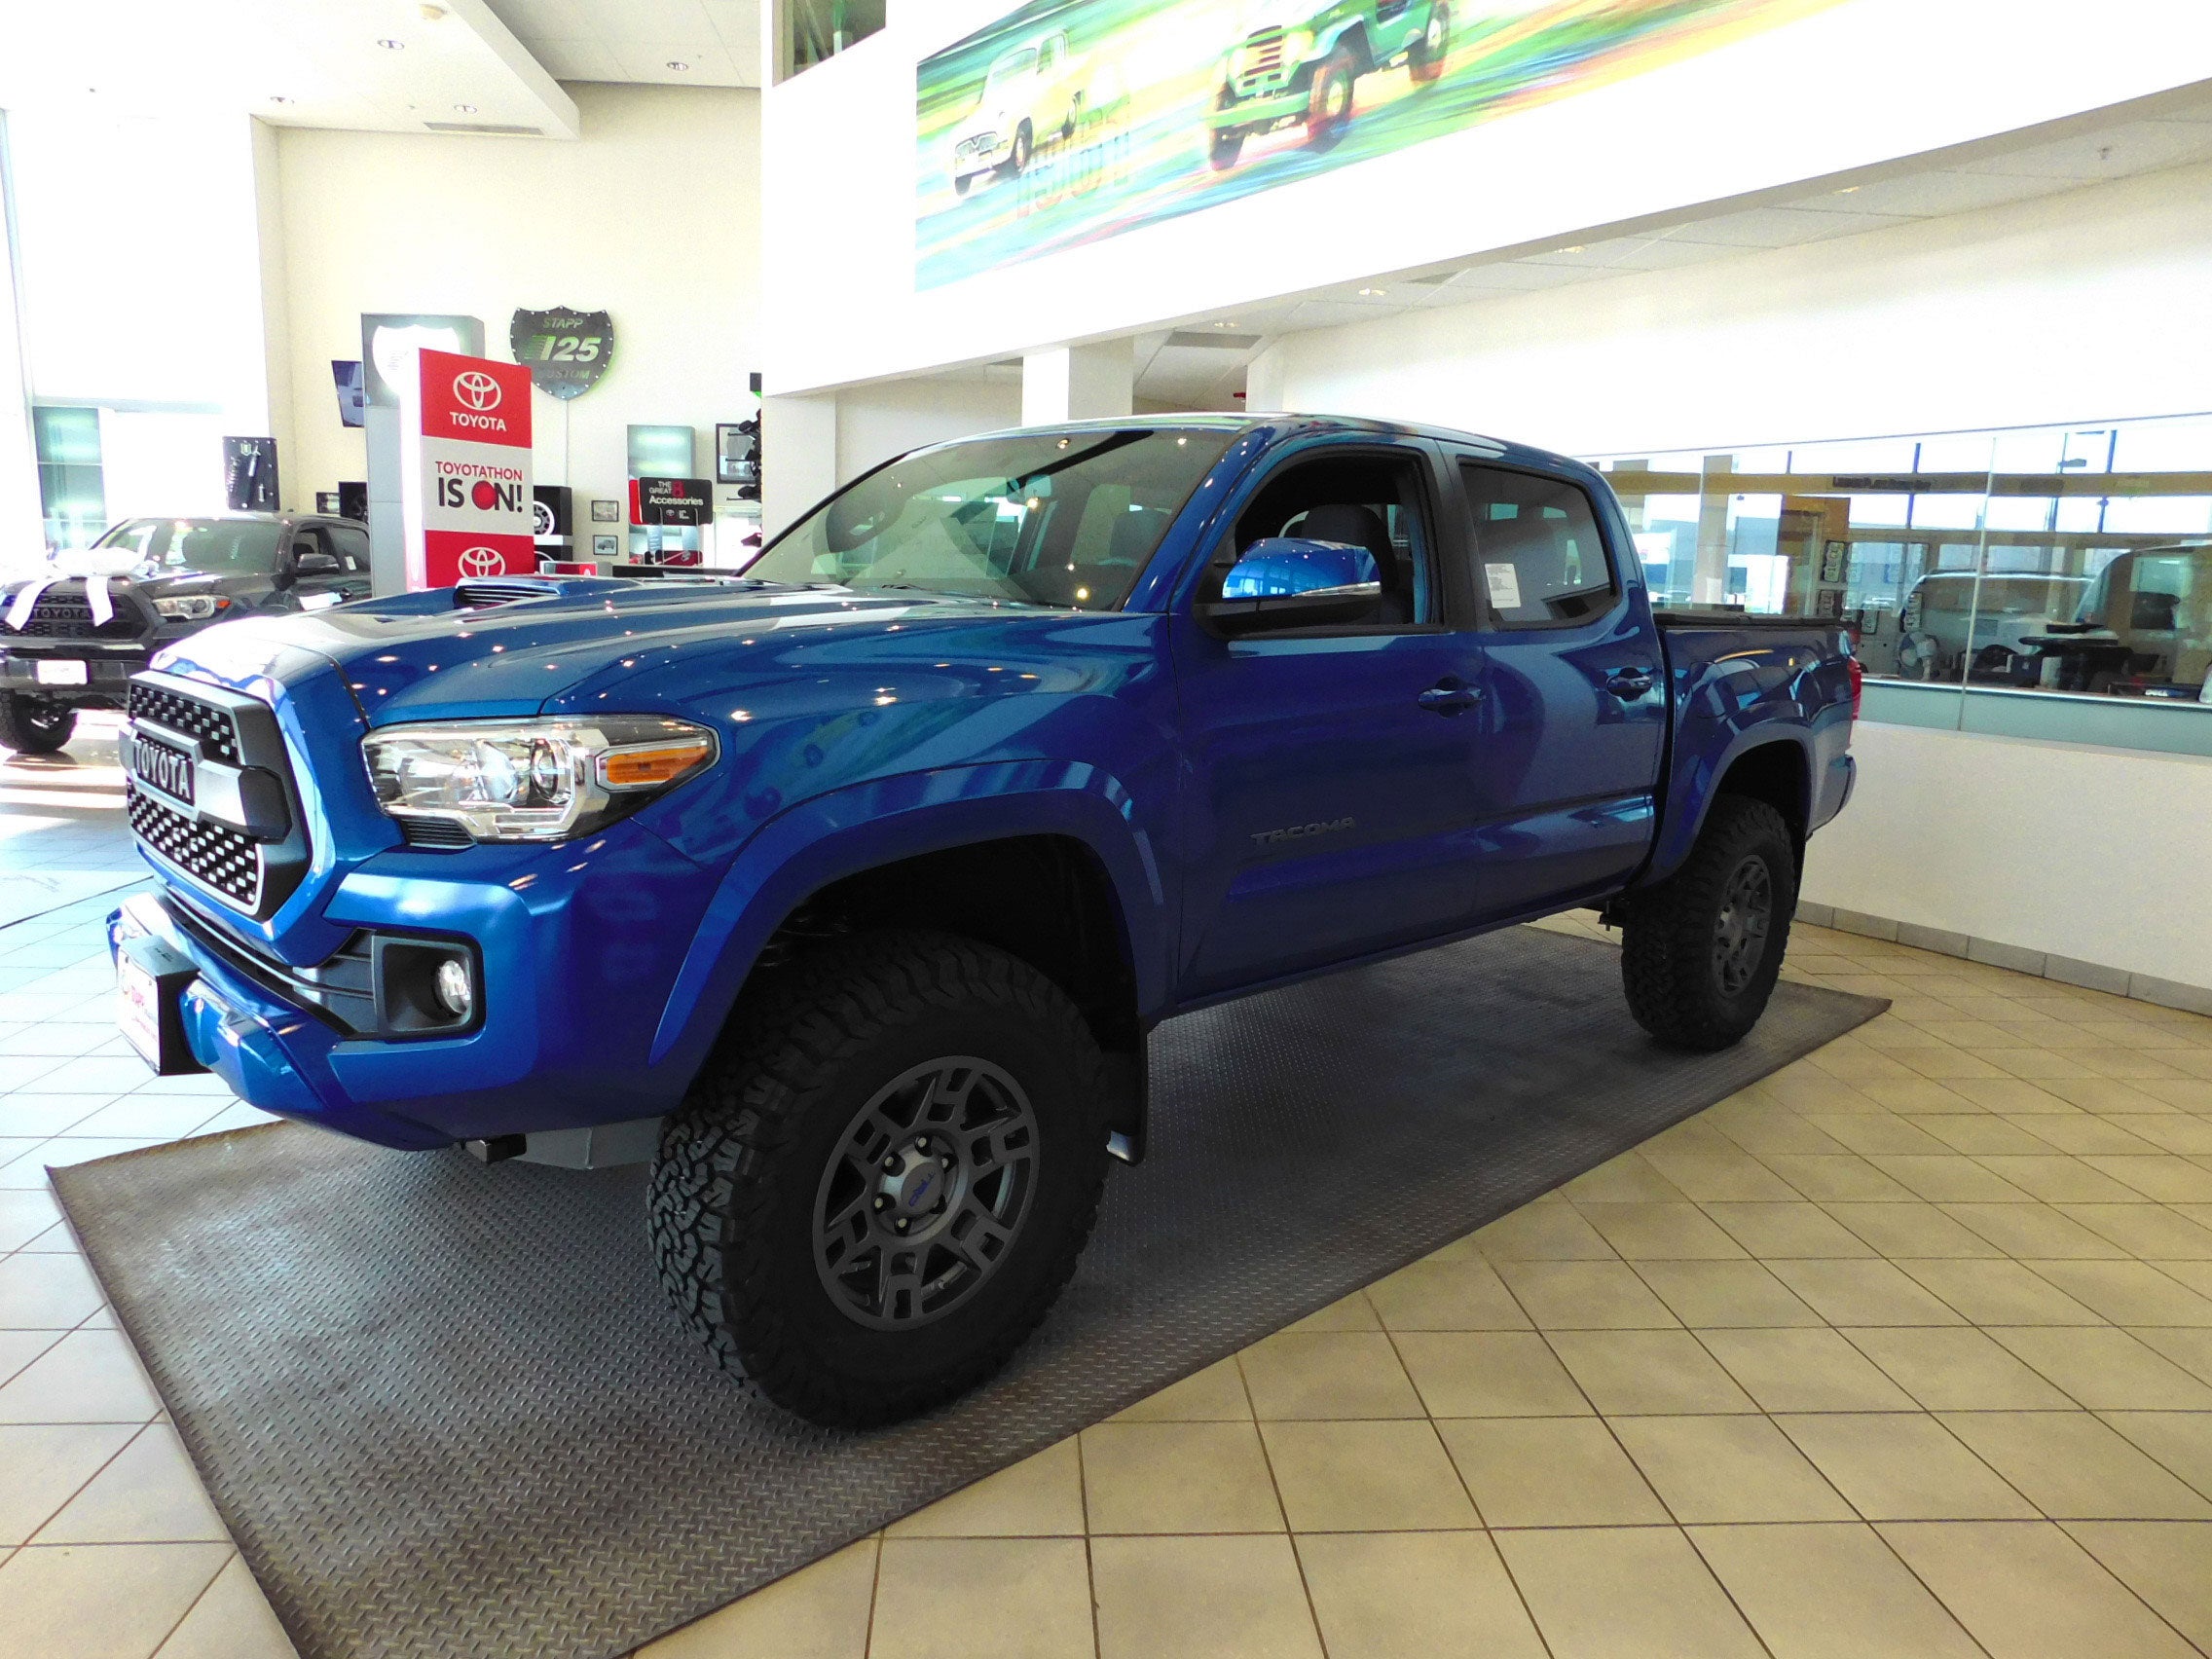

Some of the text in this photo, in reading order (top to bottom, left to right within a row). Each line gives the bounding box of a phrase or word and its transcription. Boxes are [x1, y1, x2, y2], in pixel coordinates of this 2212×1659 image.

[543, 316, 583, 329] STAPP
[450, 411, 506, 431] TOYOTA
[435, 461, 522, 482] TOYOTATHON
[438, 477, 464, 507] IS
[648, 495, 704, 506] Accessories
[33, 608, 91, 619] TOYOTA
[134, 737, 192, 799] TOYOTA
[1247, 816, 1355, 845] TACOMA
